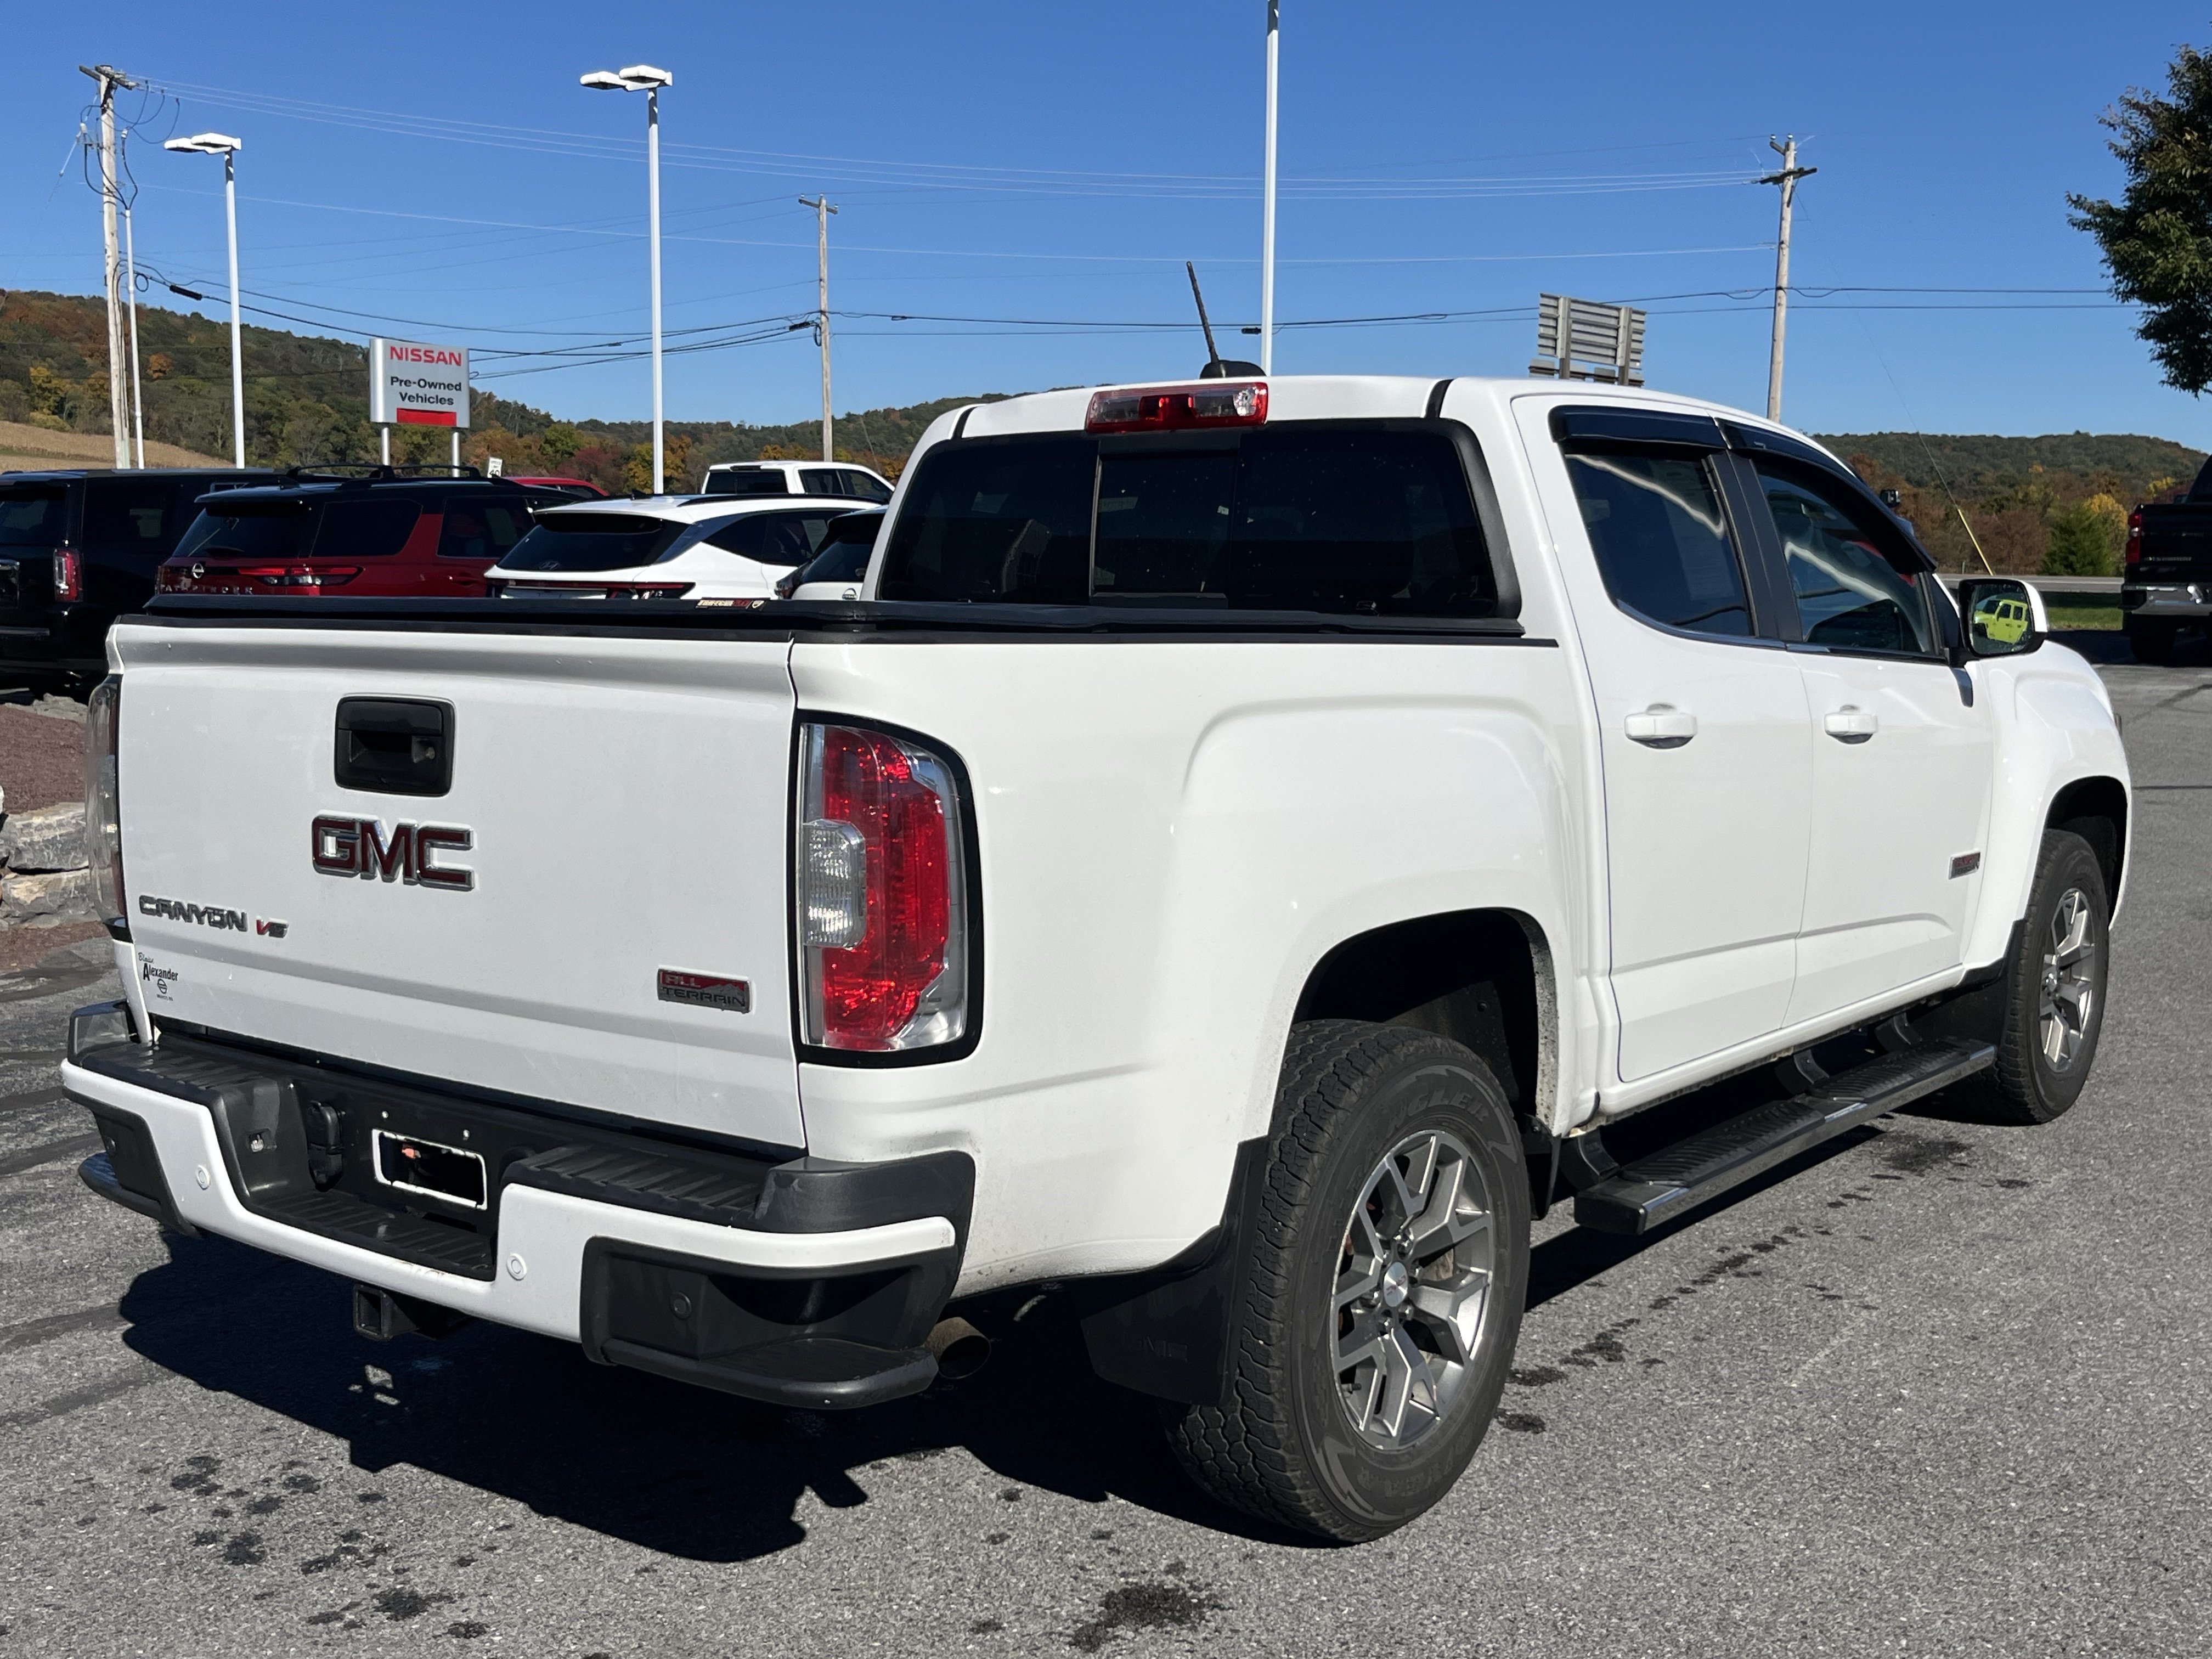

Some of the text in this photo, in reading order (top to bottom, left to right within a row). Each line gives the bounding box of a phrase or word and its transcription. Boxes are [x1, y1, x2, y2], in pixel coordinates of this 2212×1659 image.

[390, 346, 461, 366] NISSAN
[390, 376, 462, 391] Pre-Owned
[399, 392, 454, 405] Vehicles
[312, 814, 475, 891] GMC
[139, 895, 289, 938] CANYON V6
[143, 962, 178, 981] Alexander
[665, 974, 701, 988] ALL
[662, 986, 746, 1007] TERRAIN
